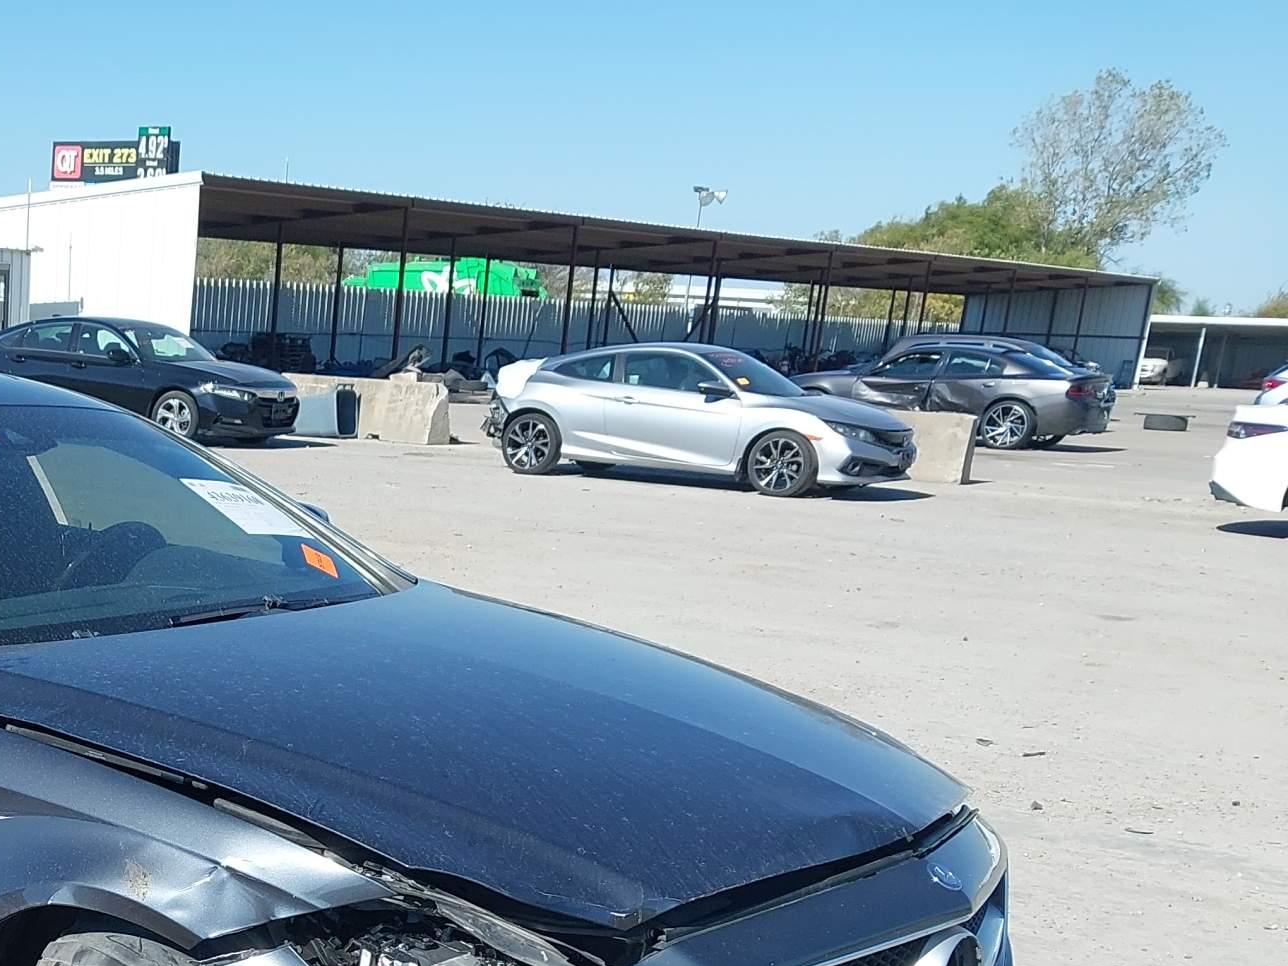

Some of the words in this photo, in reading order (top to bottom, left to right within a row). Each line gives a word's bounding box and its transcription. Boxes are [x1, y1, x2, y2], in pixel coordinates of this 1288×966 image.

[56, 149, 78, 175] QT
[83, 148, 111, 164] EXIT
[112, 147, 137, 164] 273
